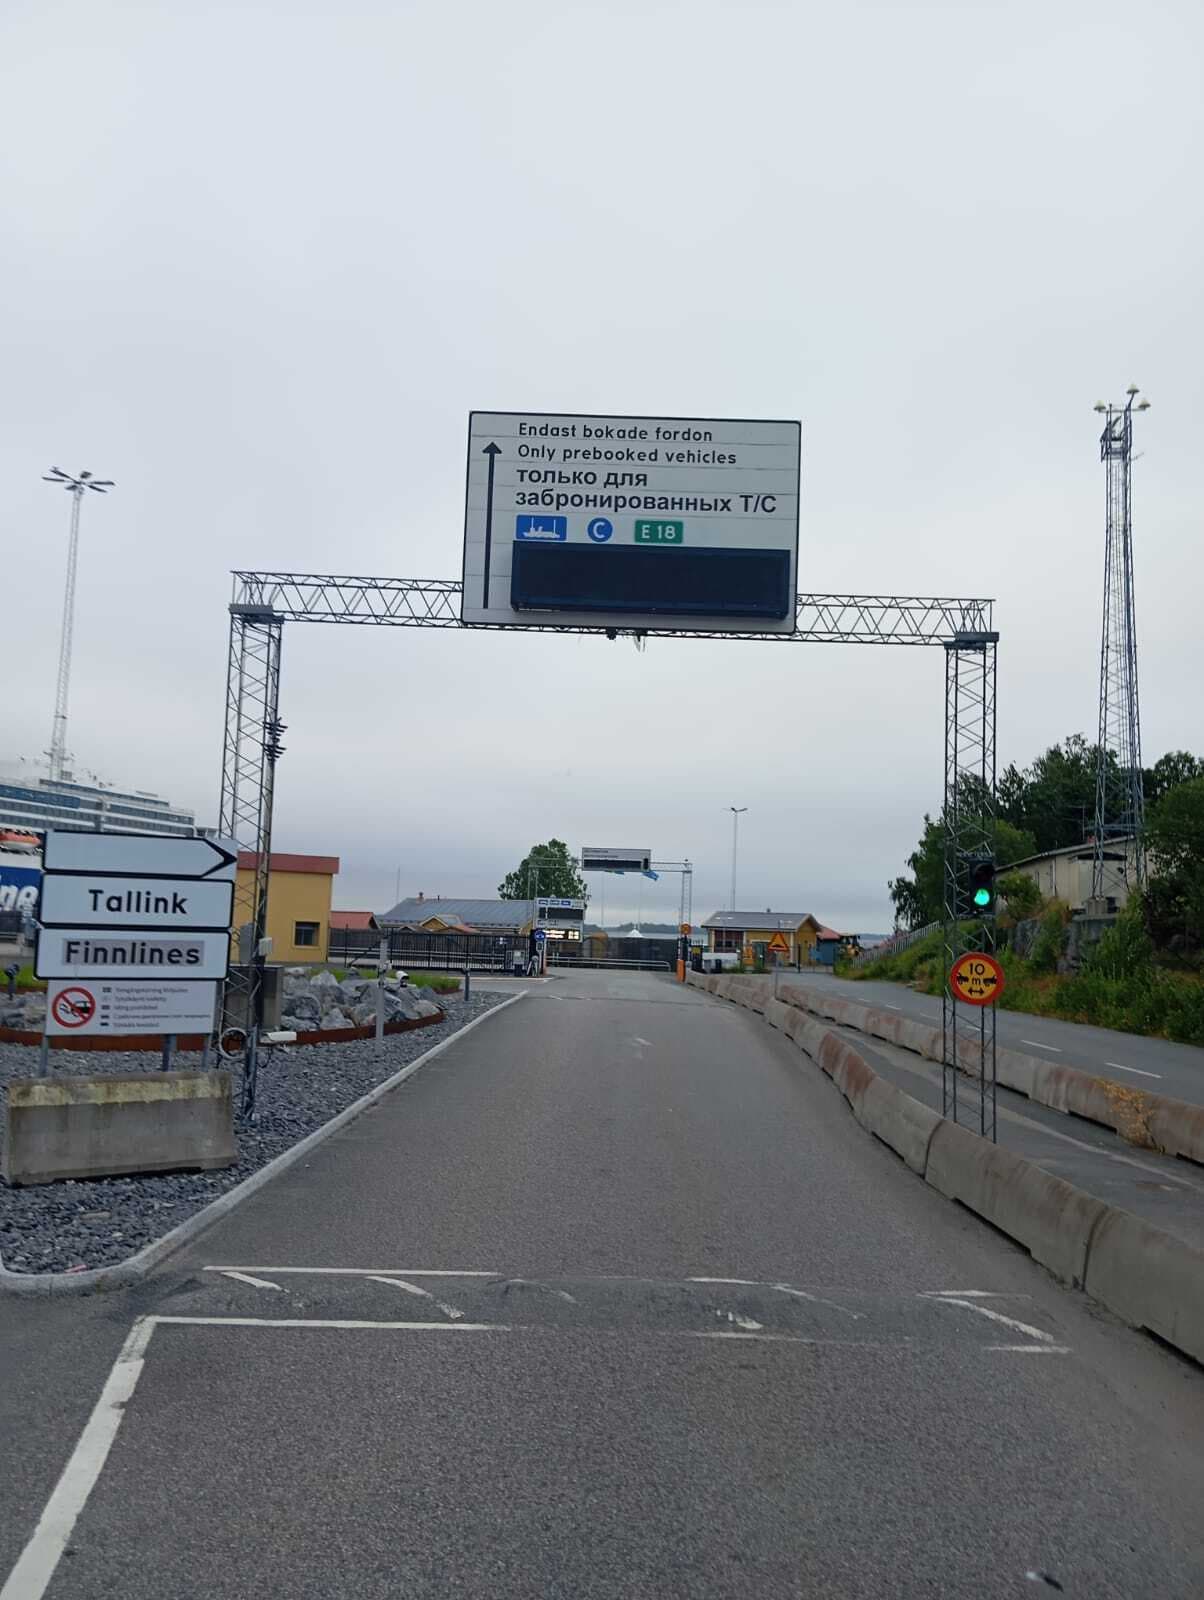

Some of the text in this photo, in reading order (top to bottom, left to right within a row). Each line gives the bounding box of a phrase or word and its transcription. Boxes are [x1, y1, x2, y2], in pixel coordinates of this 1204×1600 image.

[519, 423, 712, 442] Endast bokade fordon
[518, 445, 737, 464] Only prebooked vehicles
[517, 469, 648, 488] только для
[516, 489, 731, 512] забронированных
[593, 521, 605, 539] C
[642, 524, 676, 539] E 18
[0, 875, 38, 911] ne
[89, 889, 187, 914] Tallink
[65, 940, 200, 964] Finnlines
[970, 963, 985, 975] 10
